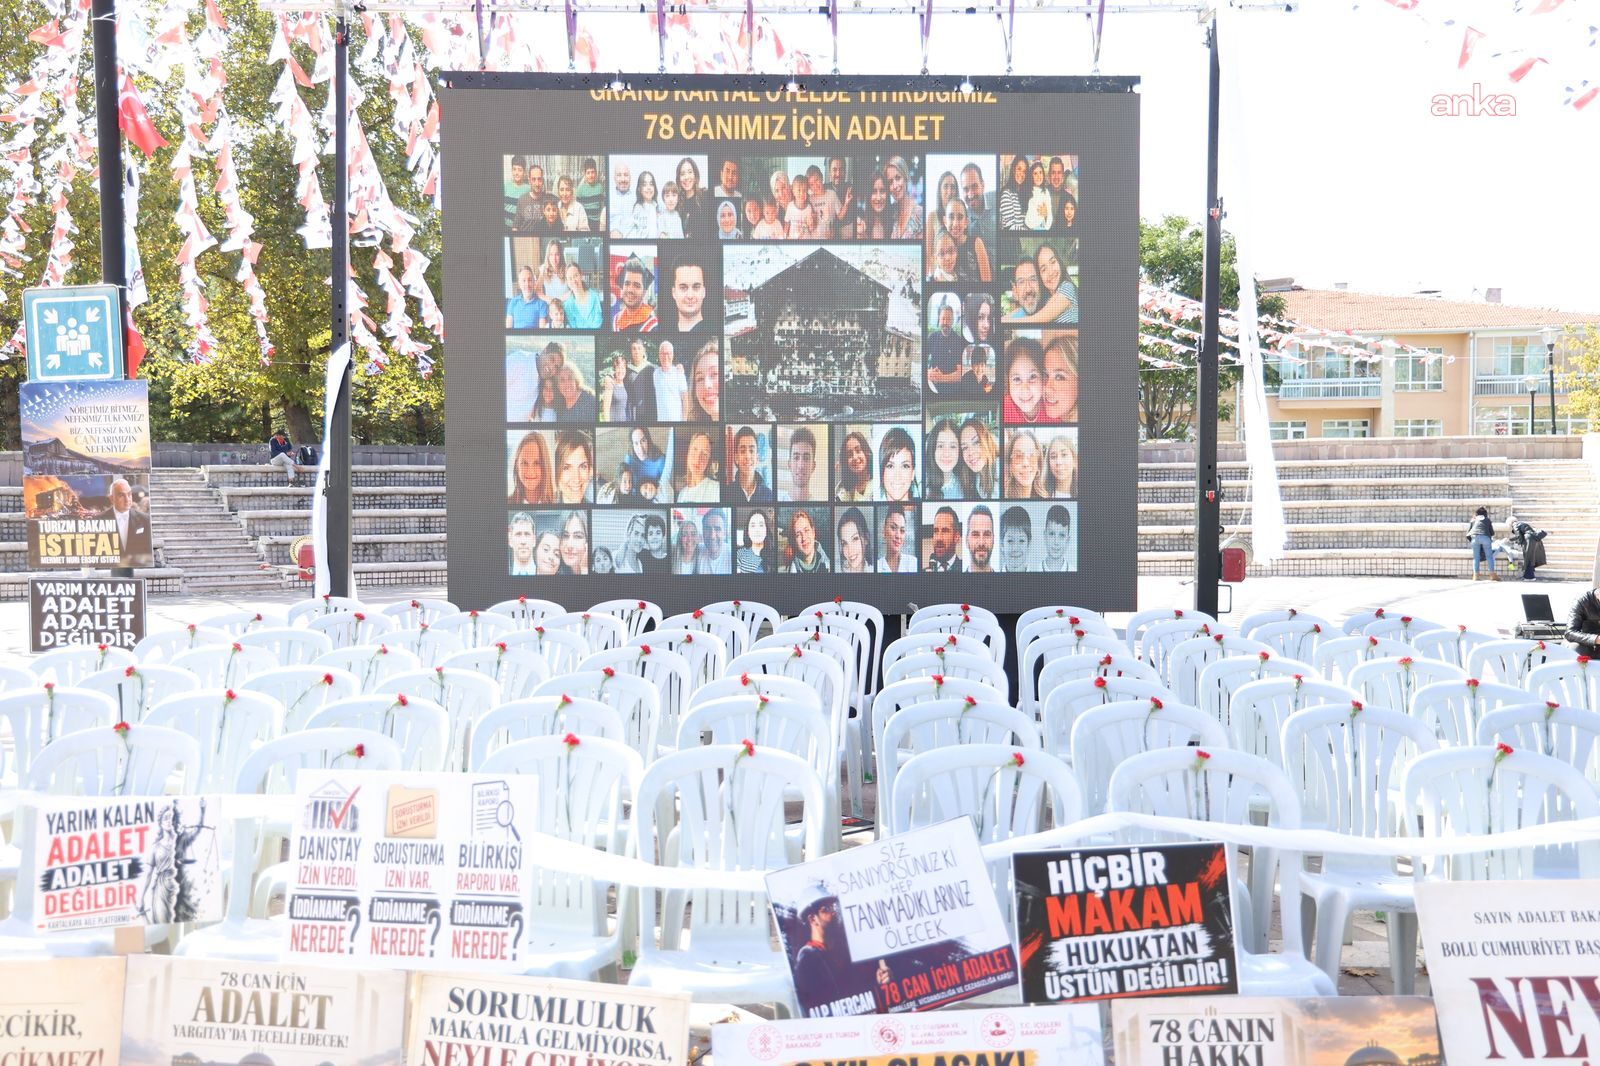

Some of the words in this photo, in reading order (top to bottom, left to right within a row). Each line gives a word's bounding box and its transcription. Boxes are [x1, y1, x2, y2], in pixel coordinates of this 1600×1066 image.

[643, 114, 675, 140] 78
[680, 114, 787, 140] CANIMIZ
[792, 108, 840, 147] İÇİN
[847, 115, 944, 141] ADALET
[119, 426, 142, 434] KALAN
[77, 519, 117, 533] BAKANI
[39, 533, 120, 557] İSTİFA!
[36, 582, 82, 596] YARIM
[86, 583, 136, 596] KALAN
[42, 596, 135, 614] ADALET
[42, 613, 135, 630] ADALET
[40, 629, 137, 647] DEĞİLDİR
[46, 808, 98, 835] YARIM
[103, 801, 155, 828] KALAN
[47, 826, 150, 867] ADALET
[299, 836, 362, 864] DANIŞTAY
[373, 842, 444, 868] SORUŞTURMA
[458, 841, 523, 871] BİLİRKİŞİ
[50, 858, 133, 891] ADALET
[298, 863, 320, 885] İZİN
[385, 868, 406, 888] İZNİ
[456, 873, 496, 891] RAPORU
[838, 852, 942, 894] SANIYORSUNUZ
[1047, 848, 1168, 897] HİÇBİR
[44, 881, 137, 916] DEĞİLDİR
[890, 880, 913, 894] HEP
[293, 896, 347, 920] İDDİANAME
[373, 898, 427, 922] İDDİANAME
[453, 901, 508, 925] İDDİANAME
[845, 879, 975, 933] TANIMADIKLARINIZ
[1045, 882, 1203, 938] MAKAM
[1473, 911, 1512, 924] SAYIN
[1517, 910, 1566, 924] ADALET
[1570, 910, 1600, 923] BAK
[884, 918, 948, 950] ÖLECEK
[1440, 941, 1478, 957] BOLU
[1481, 937, 1571, 957] CUMHURİYET
[1066, 931, 1198, 967] HUKUKTAN
[220, 971, 238, 987] 78
[242, 972, 272, 990] CAN
[276, 971, 307, 993] İÇİN
[881, 981, 902, 1007] 78
[902, 972, 931, 999] CAN
[930, 963, 960, 990] İÇİN
[961, 948, 1012, 981] ADALET
[1044, 967, 1119, 1000] ÜSTÜN
[1123, 958, 1229, 992] DEĞİLDİR!
[192, 986, 333, 1030] ADALET
[447, 985, 657, 1034] SORUMLULUK
[830, 990, 876, 1017] MERCAN
[250, 1028, 297, 1045] TECELLİ
[300, 1032, 349, 1048] EDECEK!
[428, 1016, 529, 1045] MAKAMLA
[535, 1027, 672, 1064] GELMİYORSA,
[1149, 1018, 1182, 1043] 78
[1187, 1018, 1275, 1043] CANIN
